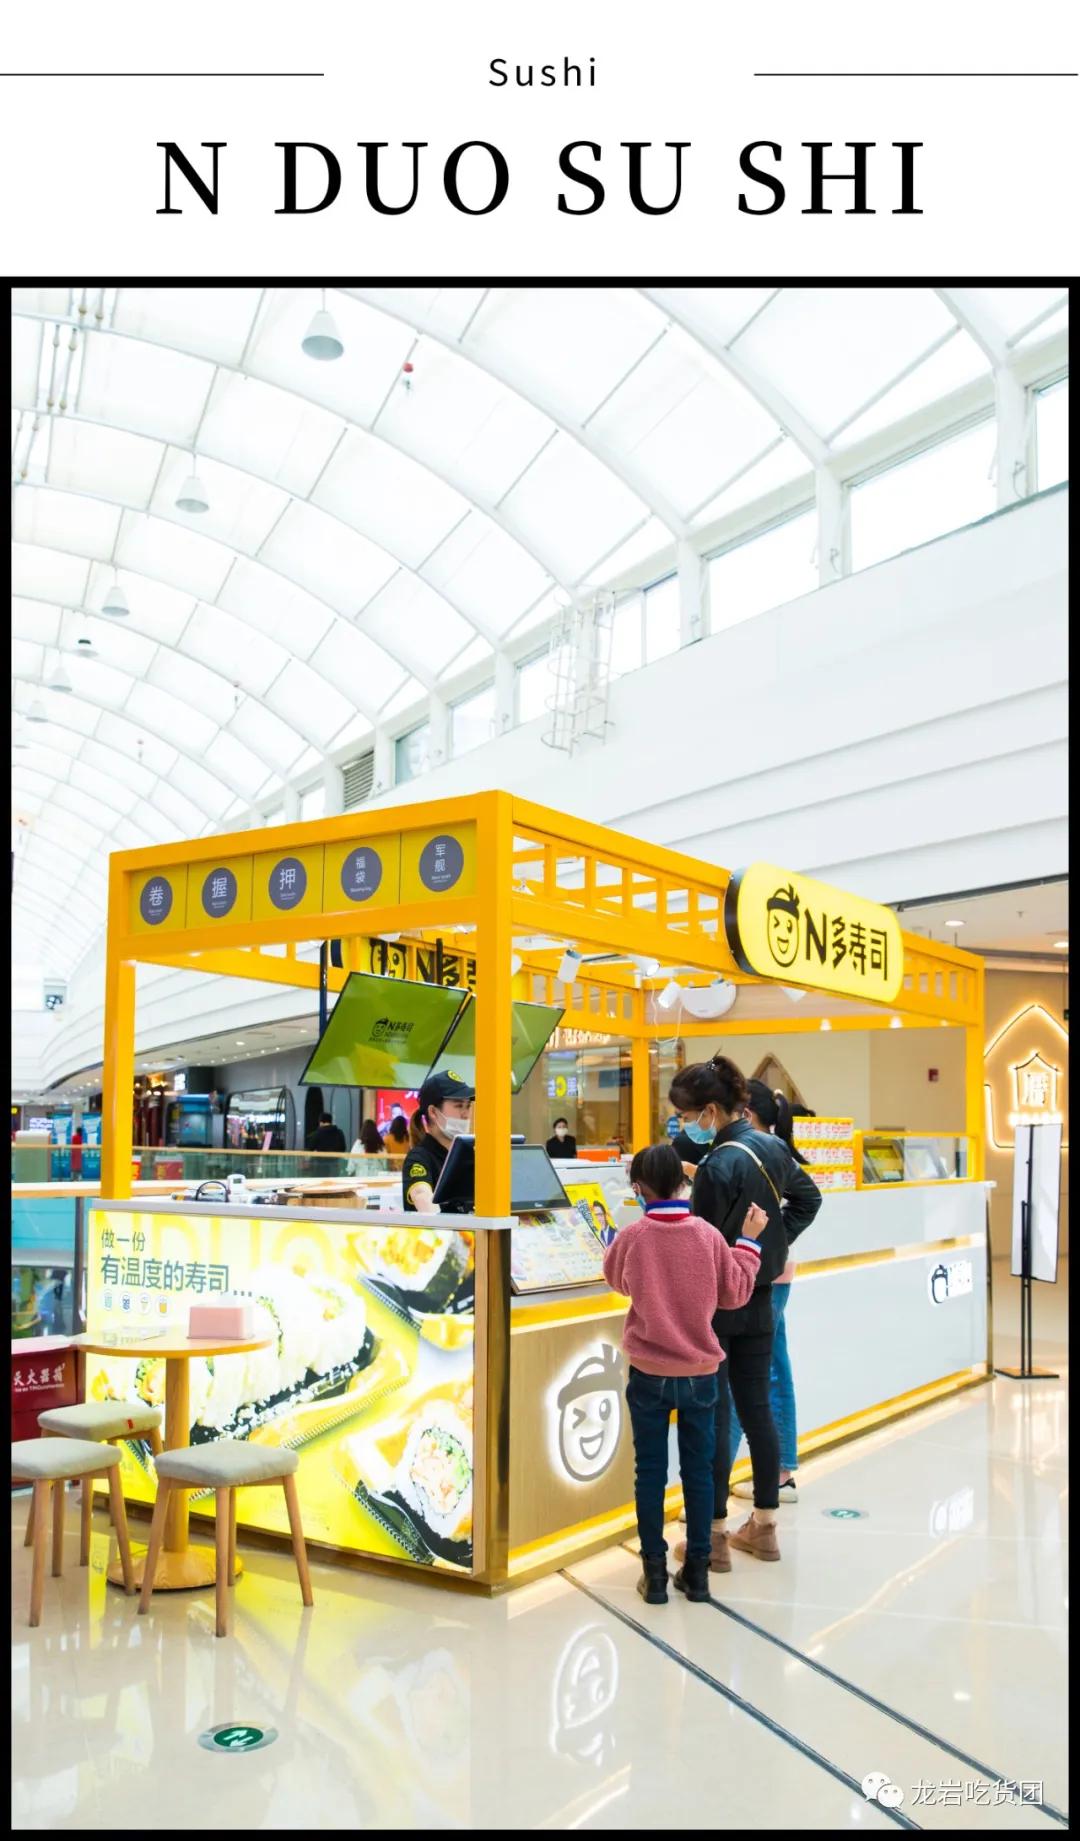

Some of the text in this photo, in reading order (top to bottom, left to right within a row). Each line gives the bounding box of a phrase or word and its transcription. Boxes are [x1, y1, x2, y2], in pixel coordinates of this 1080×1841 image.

[355, 856, 366, 884] 福袋
[435, 843, 446, 873] 军舰
[212, 877, 227, 899] 握
[279, 868, 296, 890] 押
[149, 886, 163, 906] 卷
[804, 907, 887, 981] N多寿司
[101, 1229, 146, 1253] 做一份
